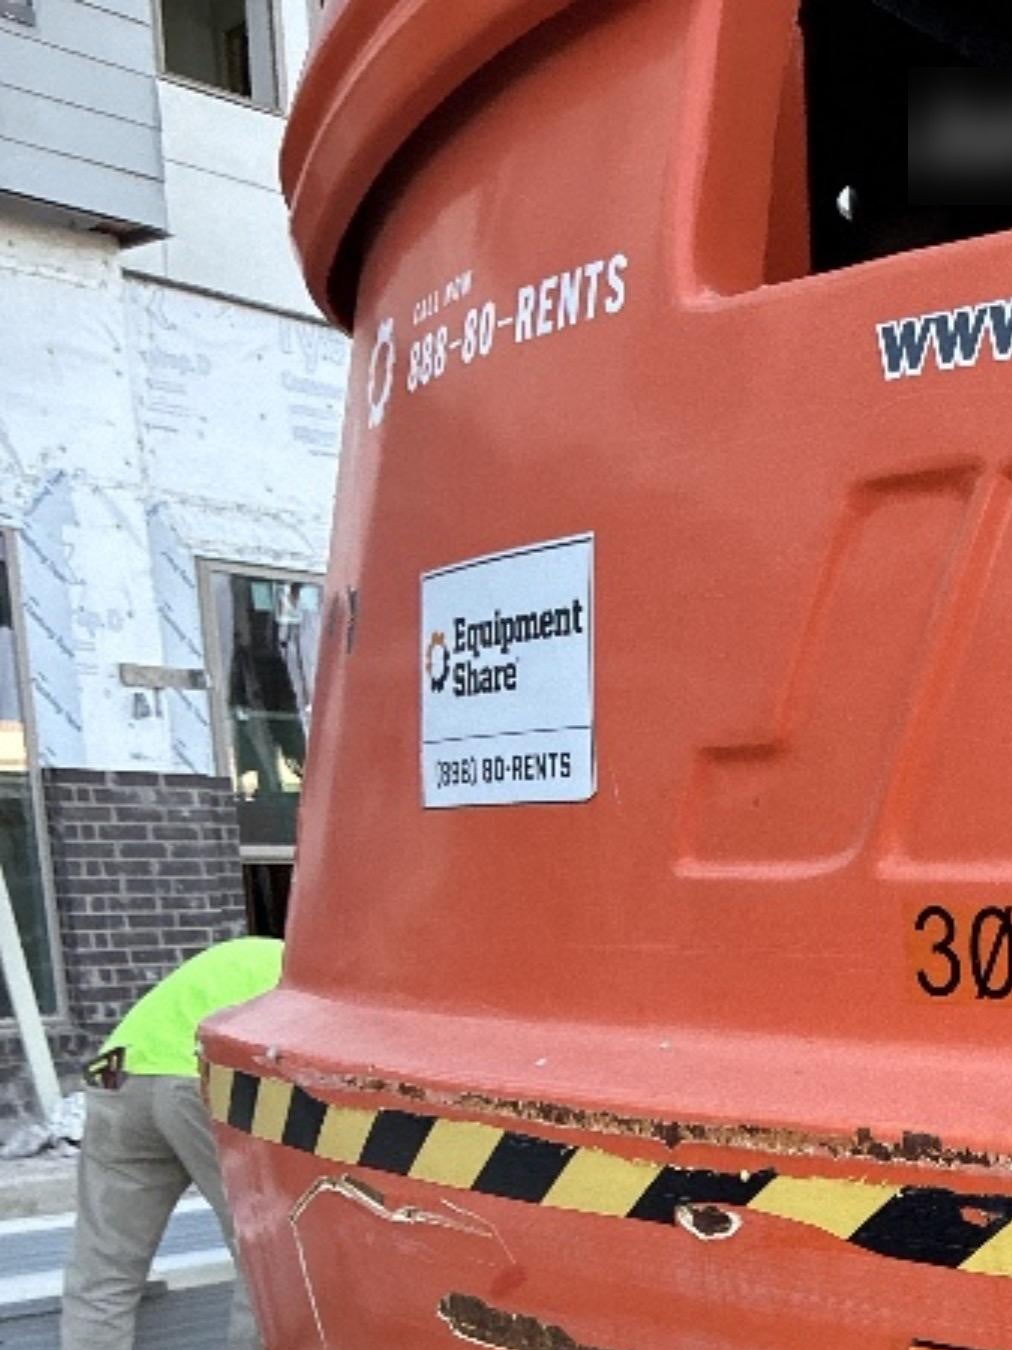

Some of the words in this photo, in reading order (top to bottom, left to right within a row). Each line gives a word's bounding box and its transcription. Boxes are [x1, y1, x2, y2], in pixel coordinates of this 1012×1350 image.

[406, 252, 629, 394] 888-80-RENTS
[452, 599, 584, 658] Equipment
[452, 660, 517, 698] Share
